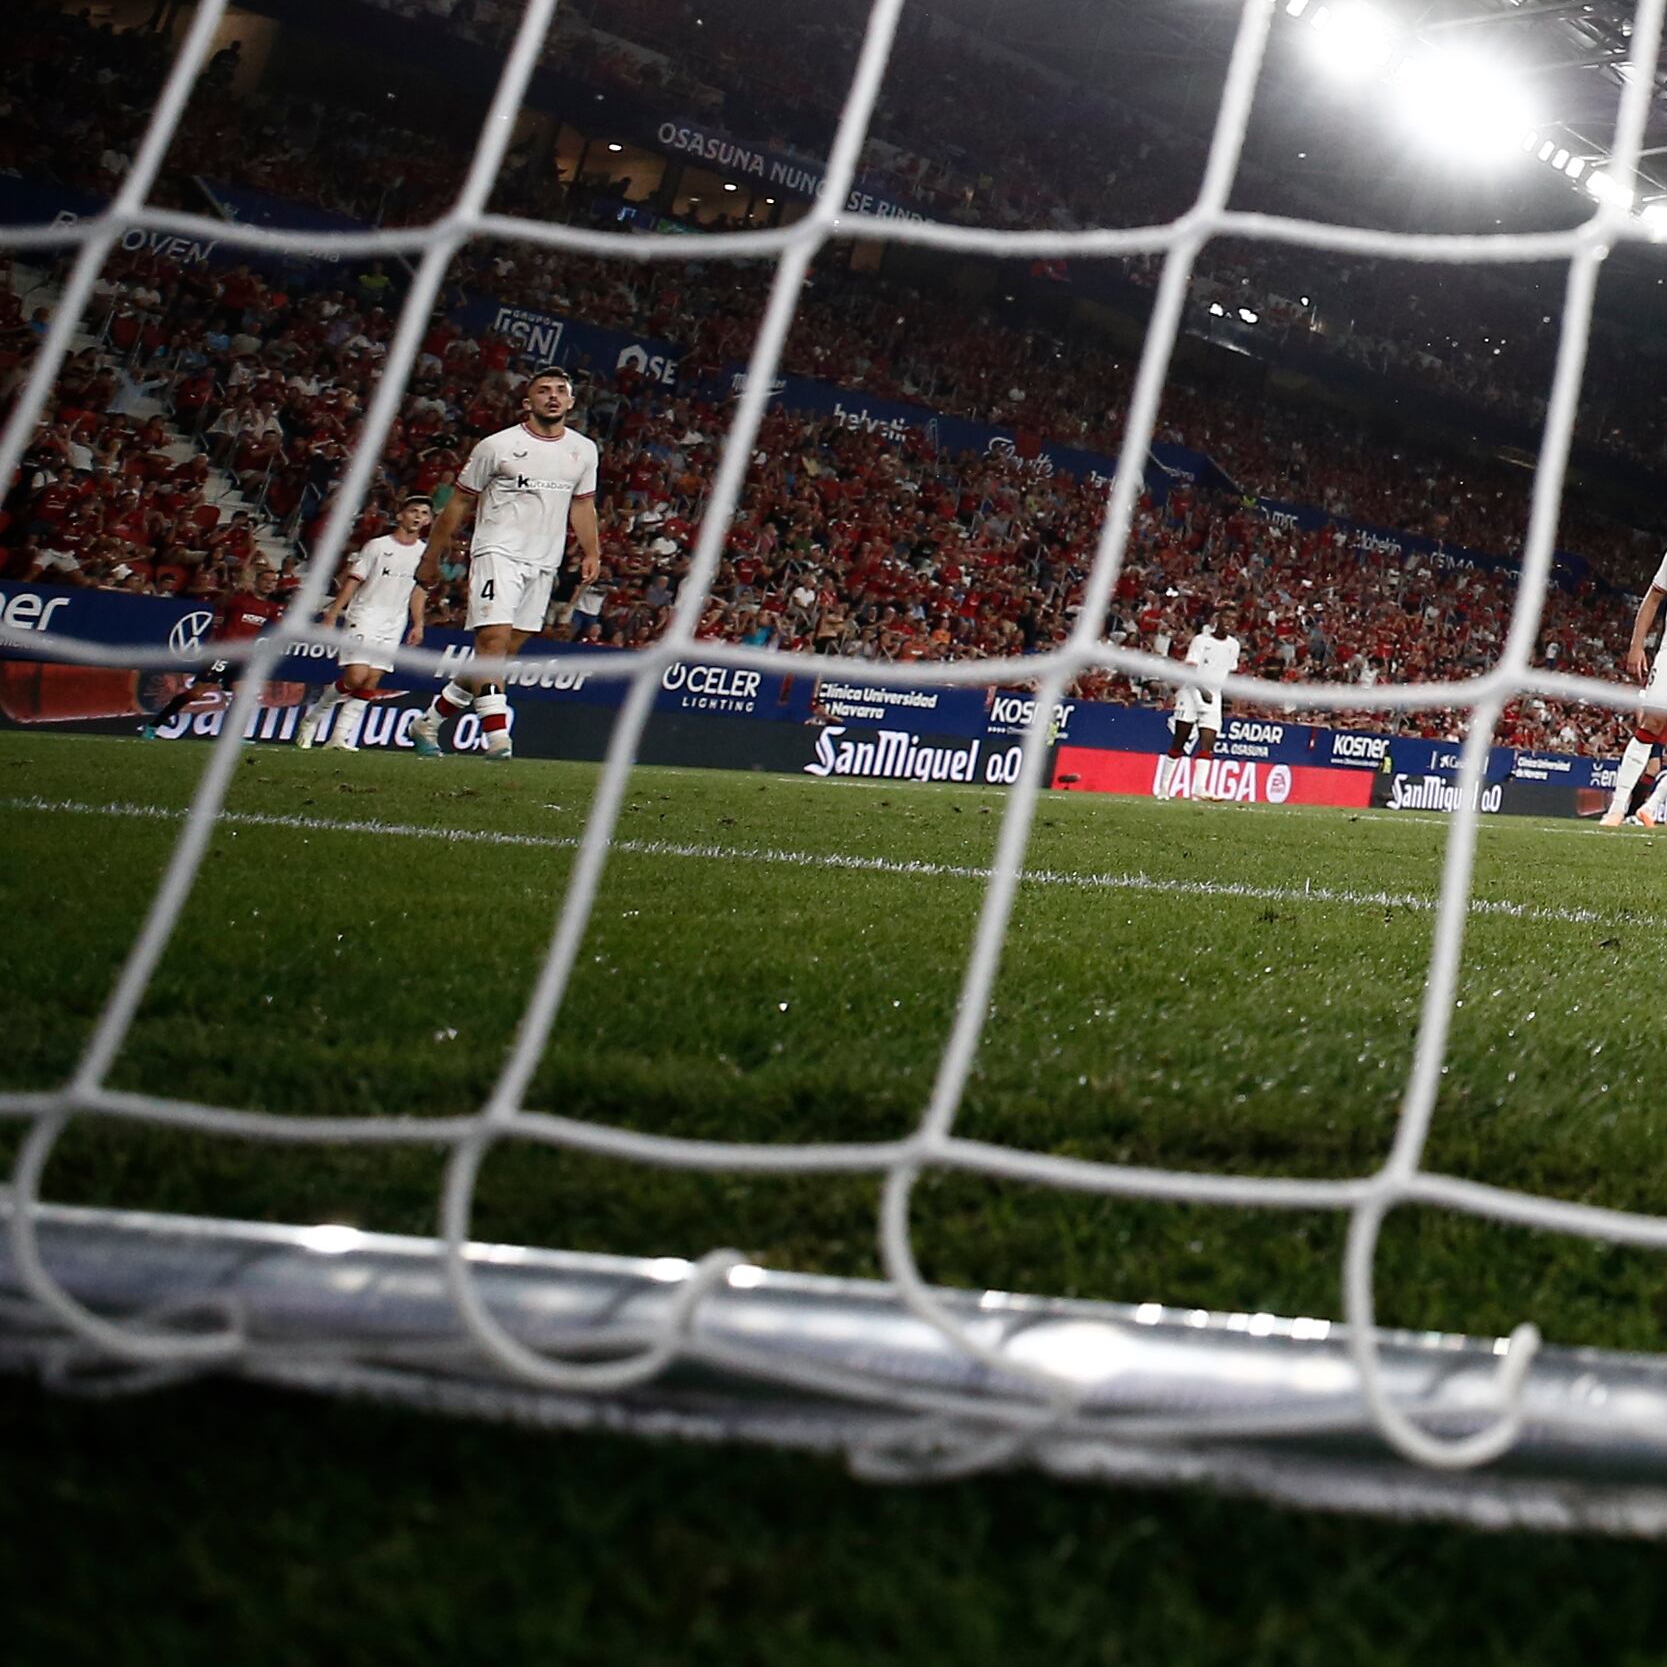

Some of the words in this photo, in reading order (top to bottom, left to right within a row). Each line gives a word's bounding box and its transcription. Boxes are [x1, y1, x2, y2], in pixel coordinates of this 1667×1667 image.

[657, 122, 765, 178] OSASUNA
[847, 190, 875, 214] SE
[481, 579, 495, 601] 4
[687, 666, 762, 699] CELER
[682, 696, 756, 714] LIGHTING
[831, 702, 886, 721] Navarra
[1229, 721, 1284, 745] SADAR
[1230, 744, 1270, 759] OSASUNA
